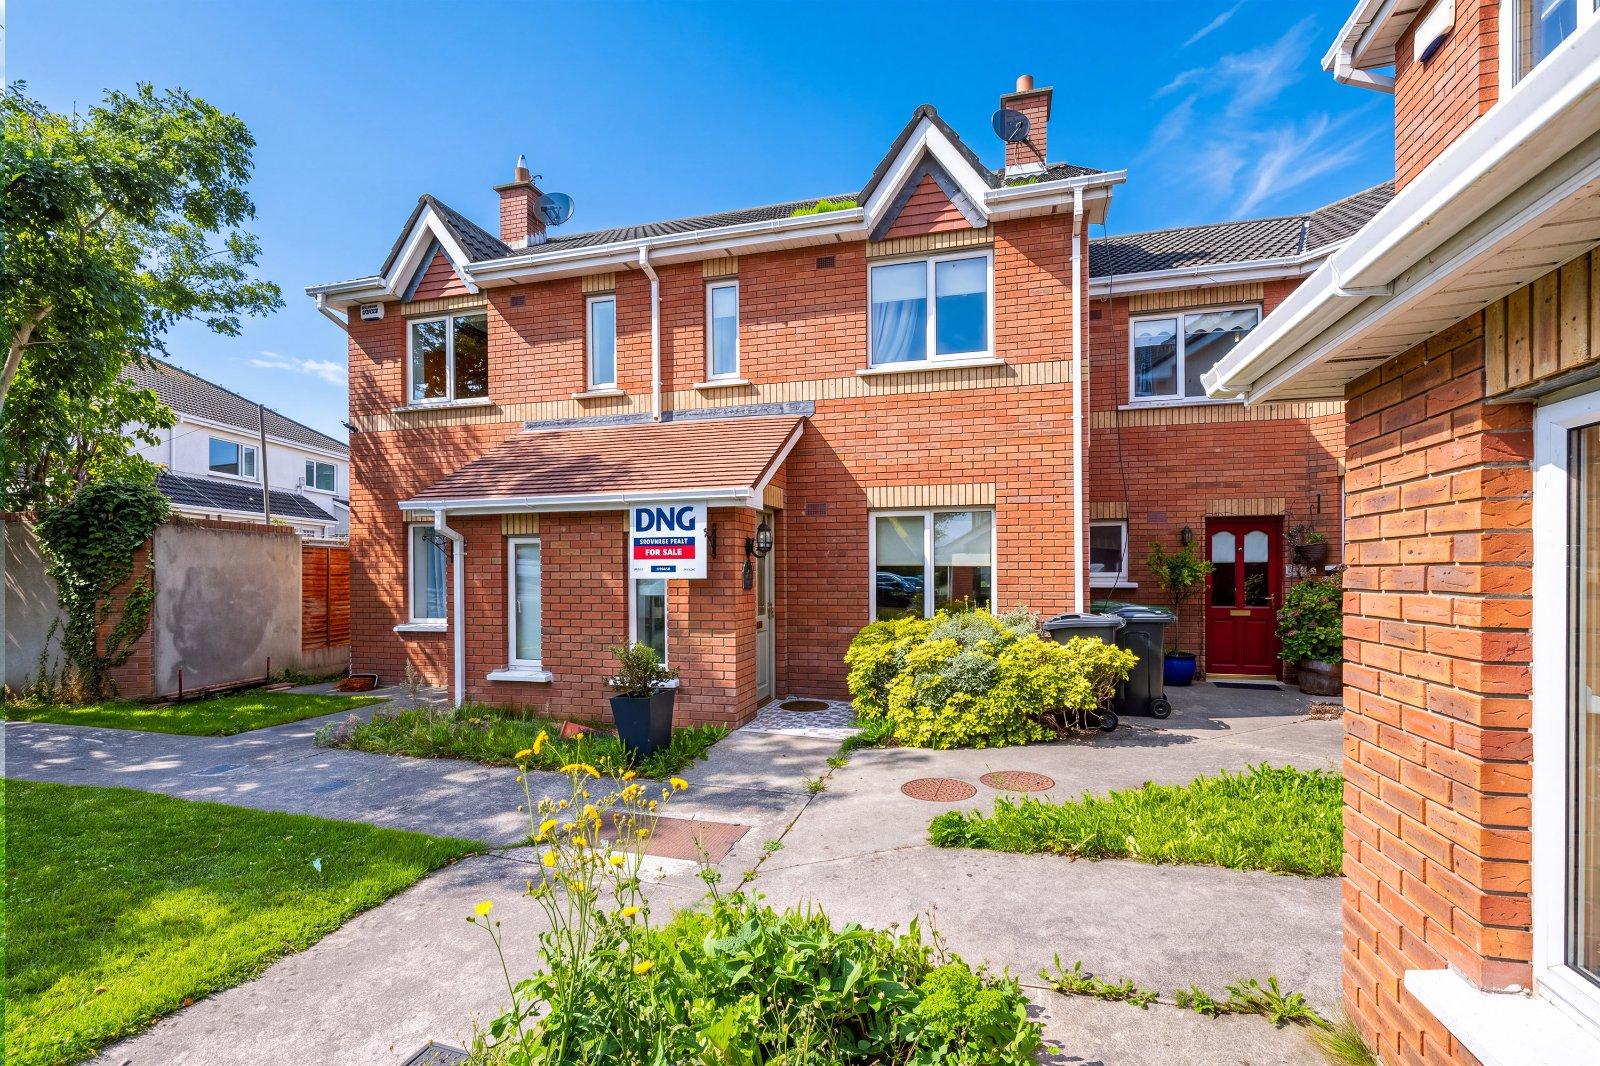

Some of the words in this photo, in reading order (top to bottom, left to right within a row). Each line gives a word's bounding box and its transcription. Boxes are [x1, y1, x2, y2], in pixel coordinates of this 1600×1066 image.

[635, 506, 696, 532] DNG
[645, 548, 661, 556] FOR
[662, 548, 683, 556] SALE
